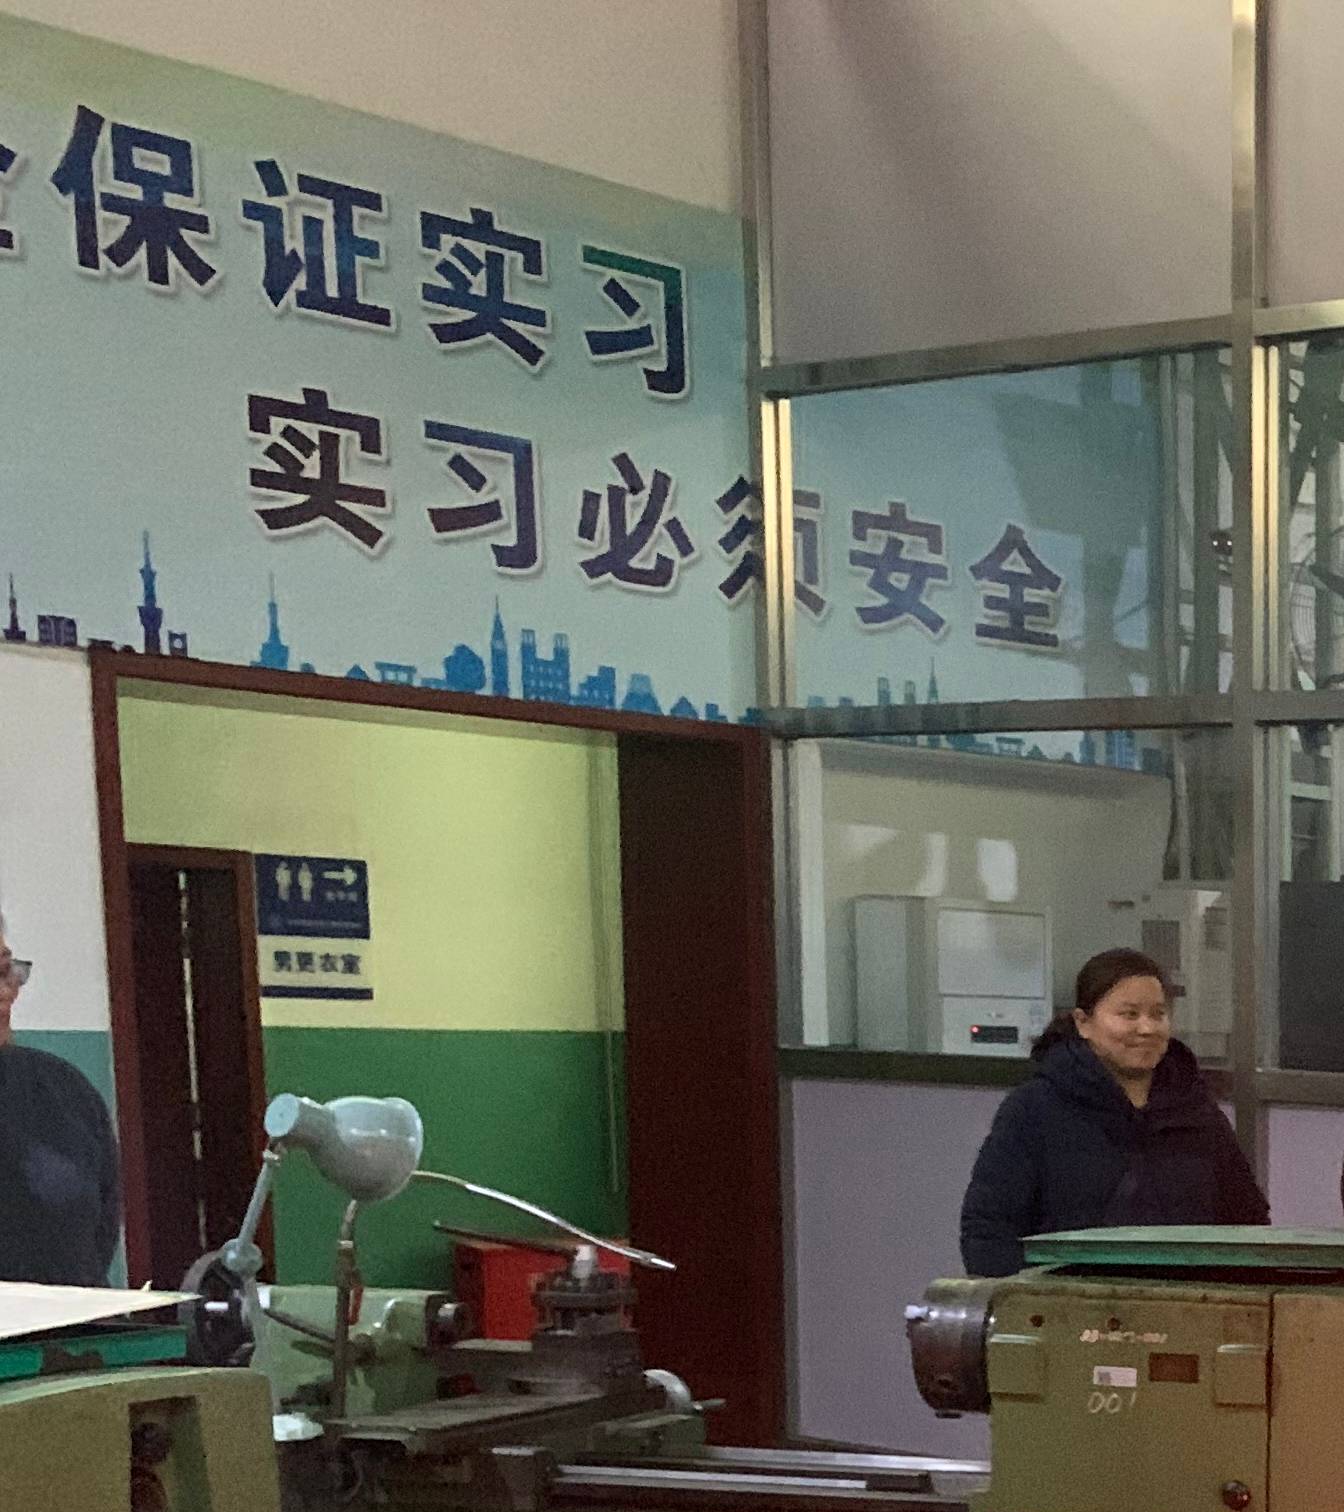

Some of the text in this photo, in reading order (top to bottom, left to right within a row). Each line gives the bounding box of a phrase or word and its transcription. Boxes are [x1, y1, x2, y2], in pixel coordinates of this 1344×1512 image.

[246, 387, 1065, 649] 实习必须安全
